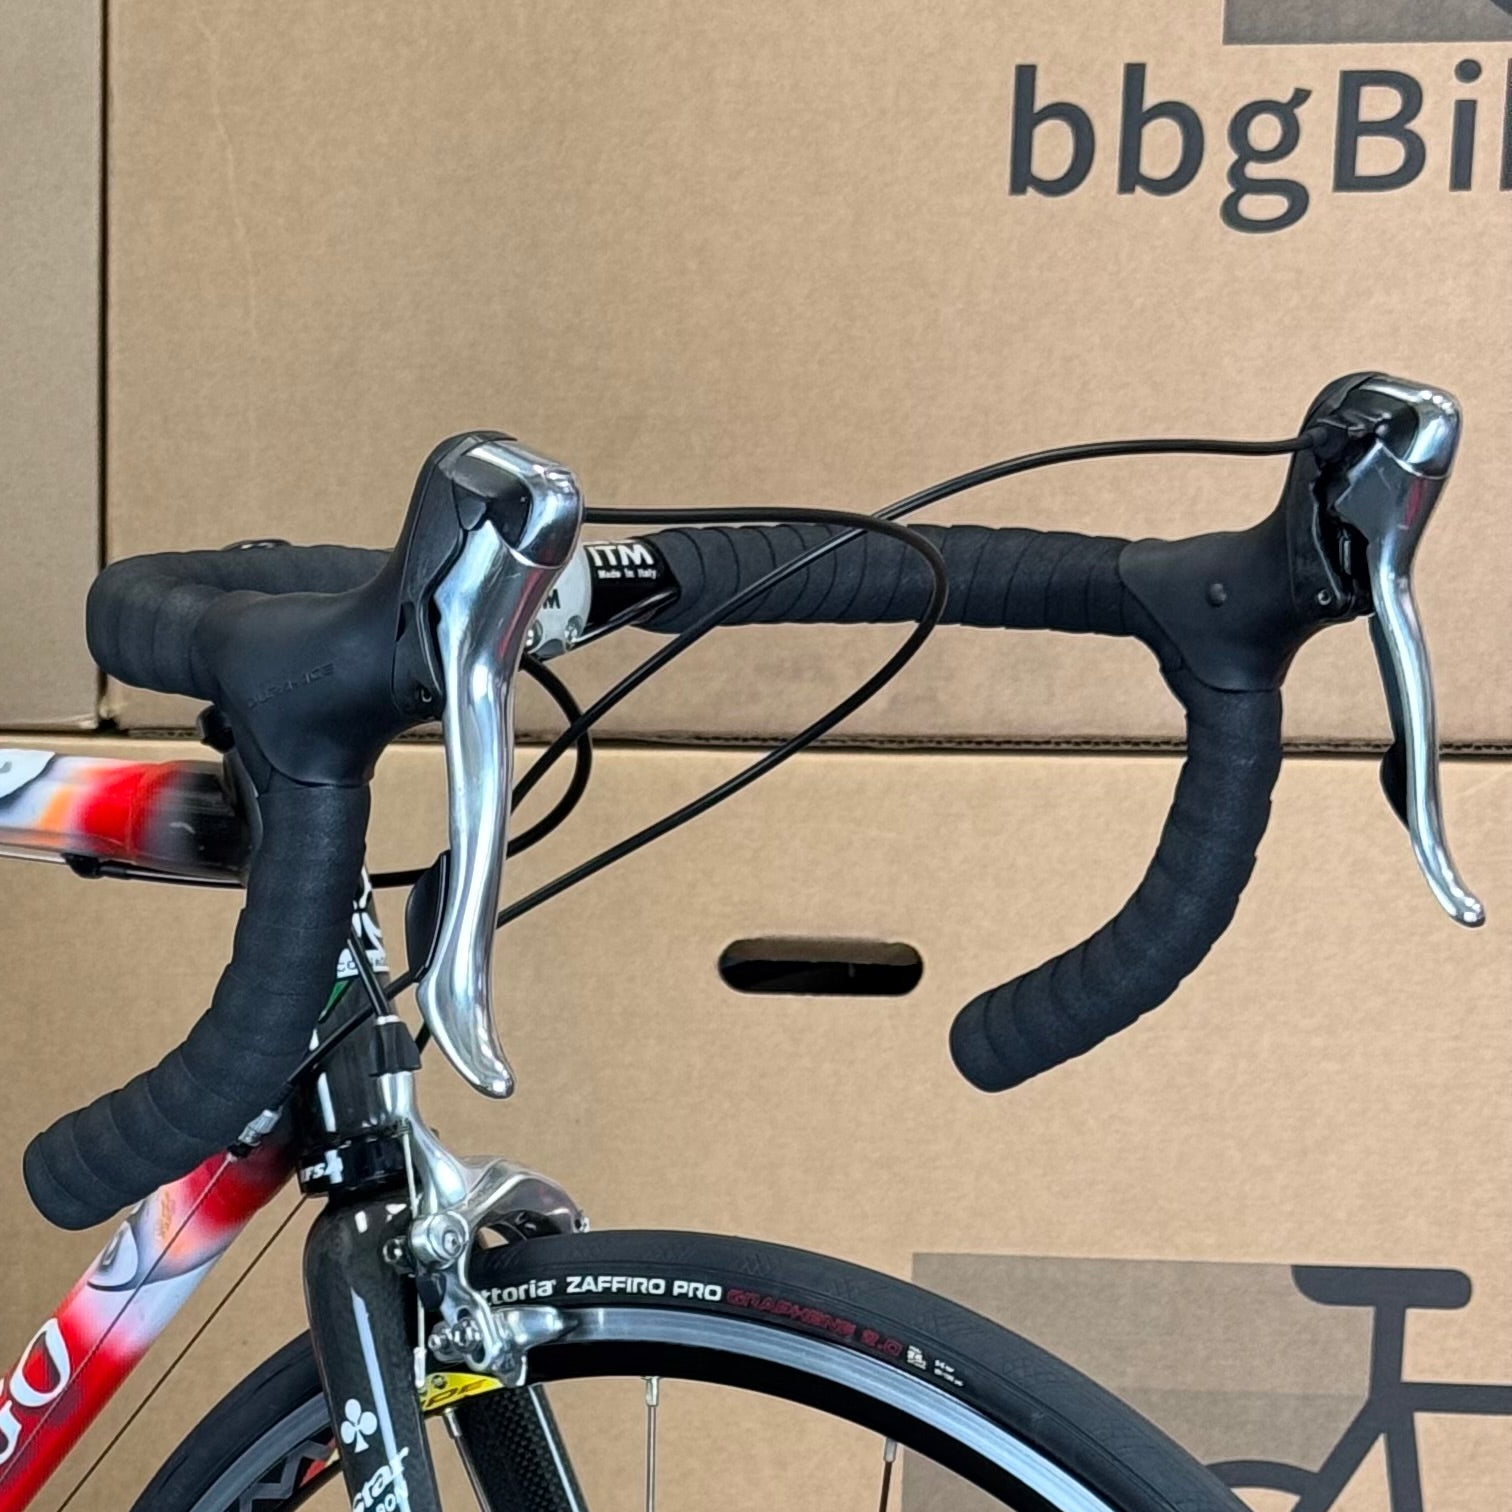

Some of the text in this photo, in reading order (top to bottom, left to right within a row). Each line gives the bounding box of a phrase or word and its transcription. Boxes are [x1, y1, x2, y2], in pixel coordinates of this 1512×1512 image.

[1008, 57, 1512, 234] bbgBi
[586, 544, 655, 567] ITM
[480, 1280, 553, 1306] ttoria
[566, 1276, 665, 1295] ZAFFIRO
[672, 1280, 722, 1301] PRO
